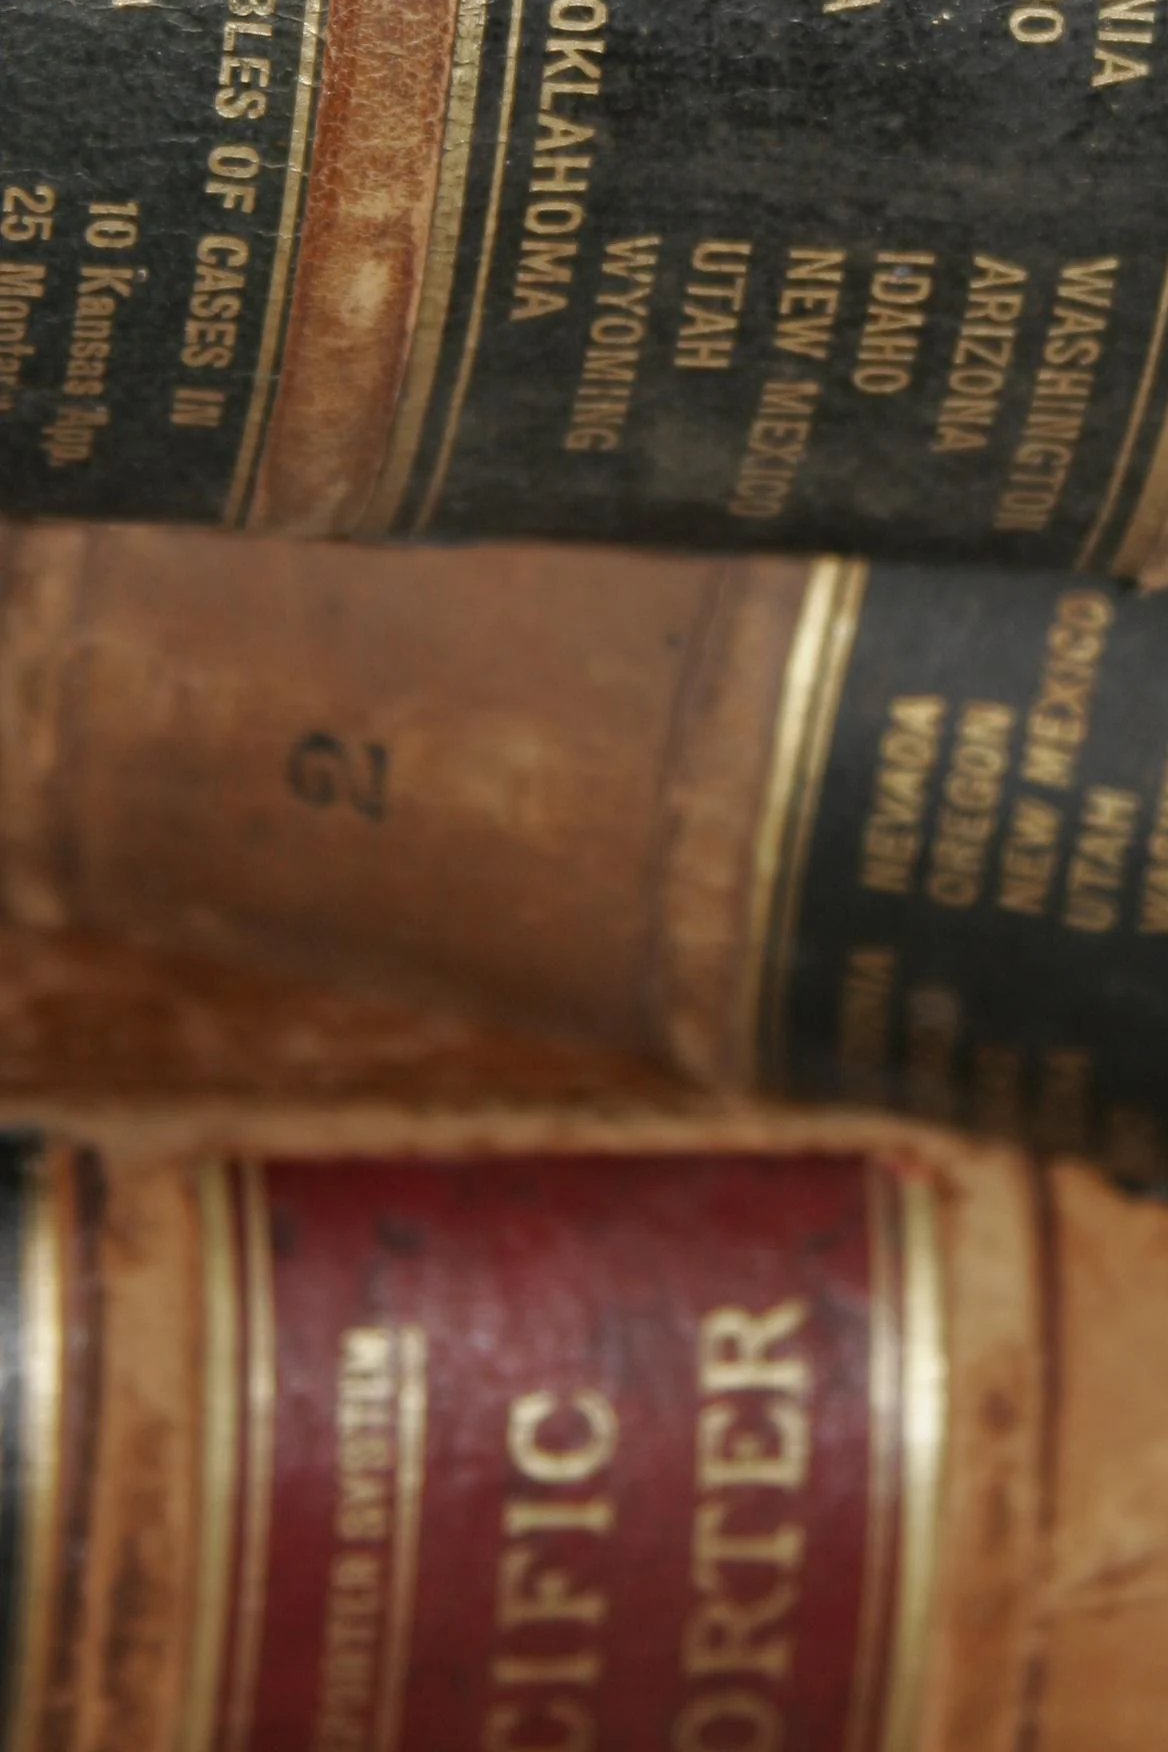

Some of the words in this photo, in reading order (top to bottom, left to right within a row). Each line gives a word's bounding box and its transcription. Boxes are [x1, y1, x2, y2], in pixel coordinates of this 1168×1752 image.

[0, 184, 57, 243] 25
[84, 199, 140, 249] 10
[206, 143, 261, 215] OF
[62, 264, 136, 397] Kansas
[180, 233, 250, 370] CASES
[563, 233, 662, 451] WYOMING
[673, 241, 752, 370] UTAH
[774, 247, 845, 360] NEW
[851, 252, 936, 395] IDAHO
[929, 254, 1027, 453] ARIZONA
[170, 386, 227, 428] IN
[727, 378, 821, 520] MEXICO
[992, 256, 1120, 533] WASHINGTON
[1020, 588, 1116, 791] MEXICO
[861, 694, 947, 894] NEVADA
[923, 700, 1017, 910] OREGON
[995, 796, 1064, 915] NEW
[1062, 785, 1140, 933] UTAH
